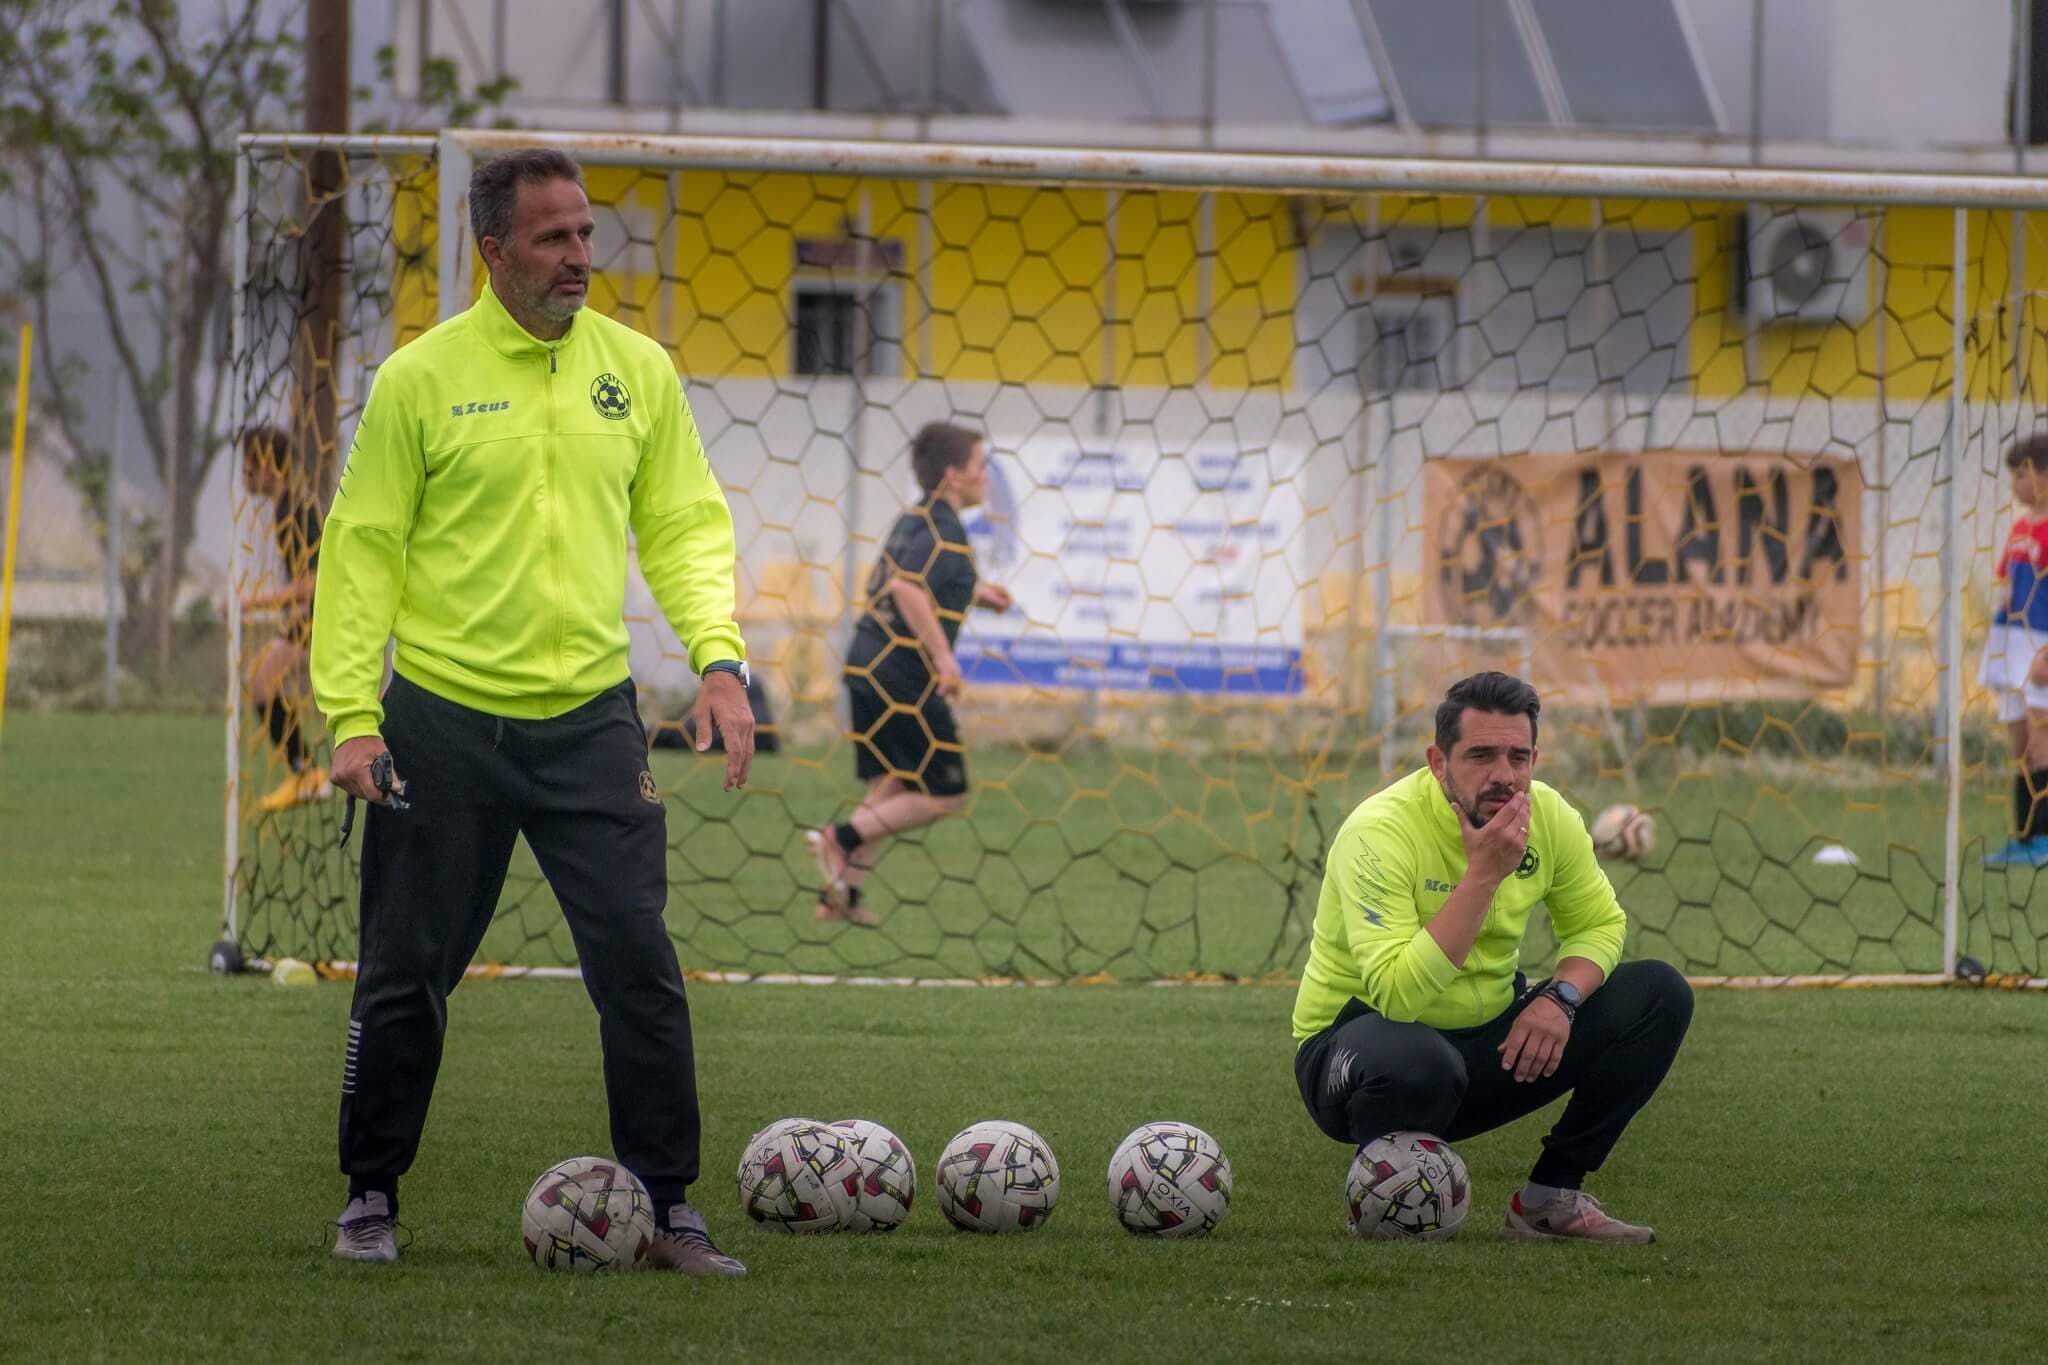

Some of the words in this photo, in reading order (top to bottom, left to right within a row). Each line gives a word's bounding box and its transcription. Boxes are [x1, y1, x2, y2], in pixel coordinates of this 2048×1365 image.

[465, 401, 510, 415] Zeus
[1566, 465, 1847, 588] ALANA
[1563, 594, 1677, 650] SOCCER
[1410, 1143, 1438, 1179] OXIA
[1157, 1183, 1191, 1217] OXIA
